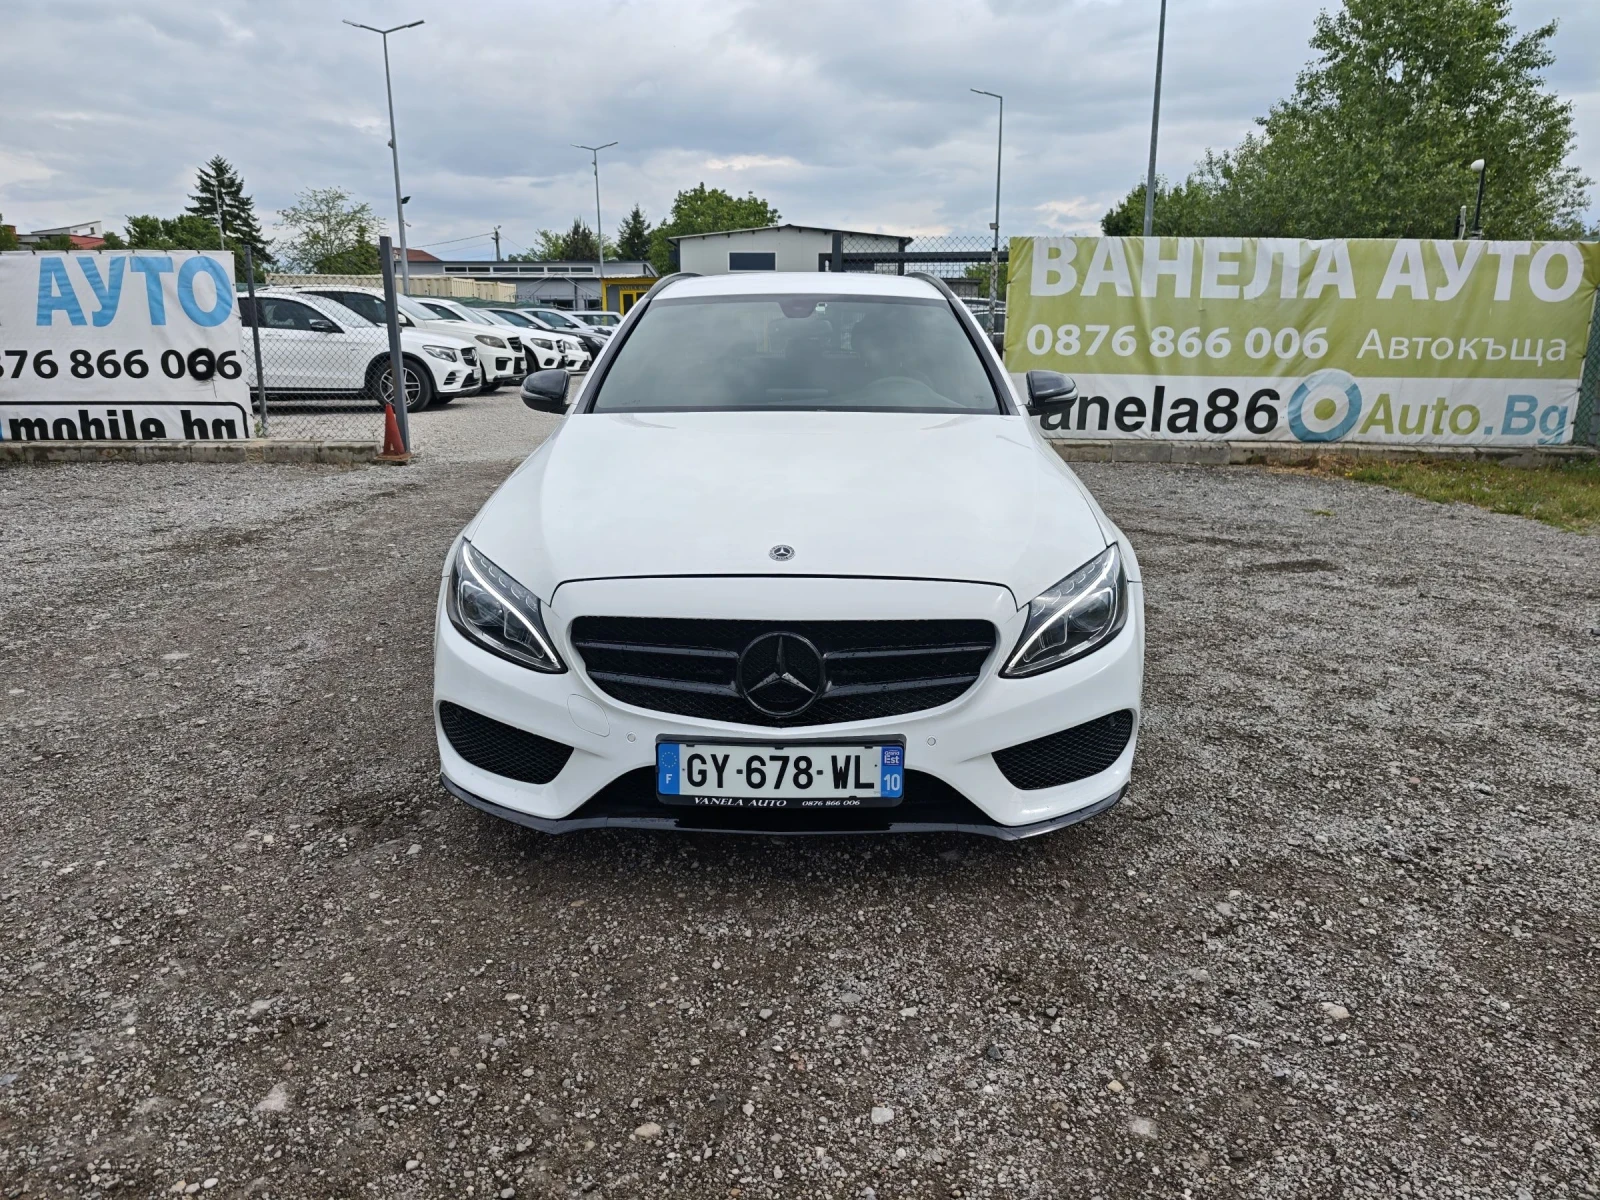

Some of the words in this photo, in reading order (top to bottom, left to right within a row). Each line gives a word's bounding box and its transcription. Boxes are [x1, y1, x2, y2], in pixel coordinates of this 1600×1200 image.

[1030, 238, 1356, 300] ВАНЕЛА
[1376, 240, 1584, 303] АУТО
[36, 256, 234, 327] АУТО
[1026, 324, 1137, 357] 0876
[1149, 326, 1232, 359] 866
[1244, 327, 1329, 360] 006
[1356, 328, 1567, 367] Автокъща
[0, 349, 59, 379] 76
[70, 349, 149, 379] 866
[686, 753, 875, 790] GY-678-WL
[884, 755, 900, 764] Est
[665, 773, 673, 784] F
[883, 773, 901, 791] 10
[694, 797, 744, 806] VANELA
[748, 799, 787, 807] AUTO
